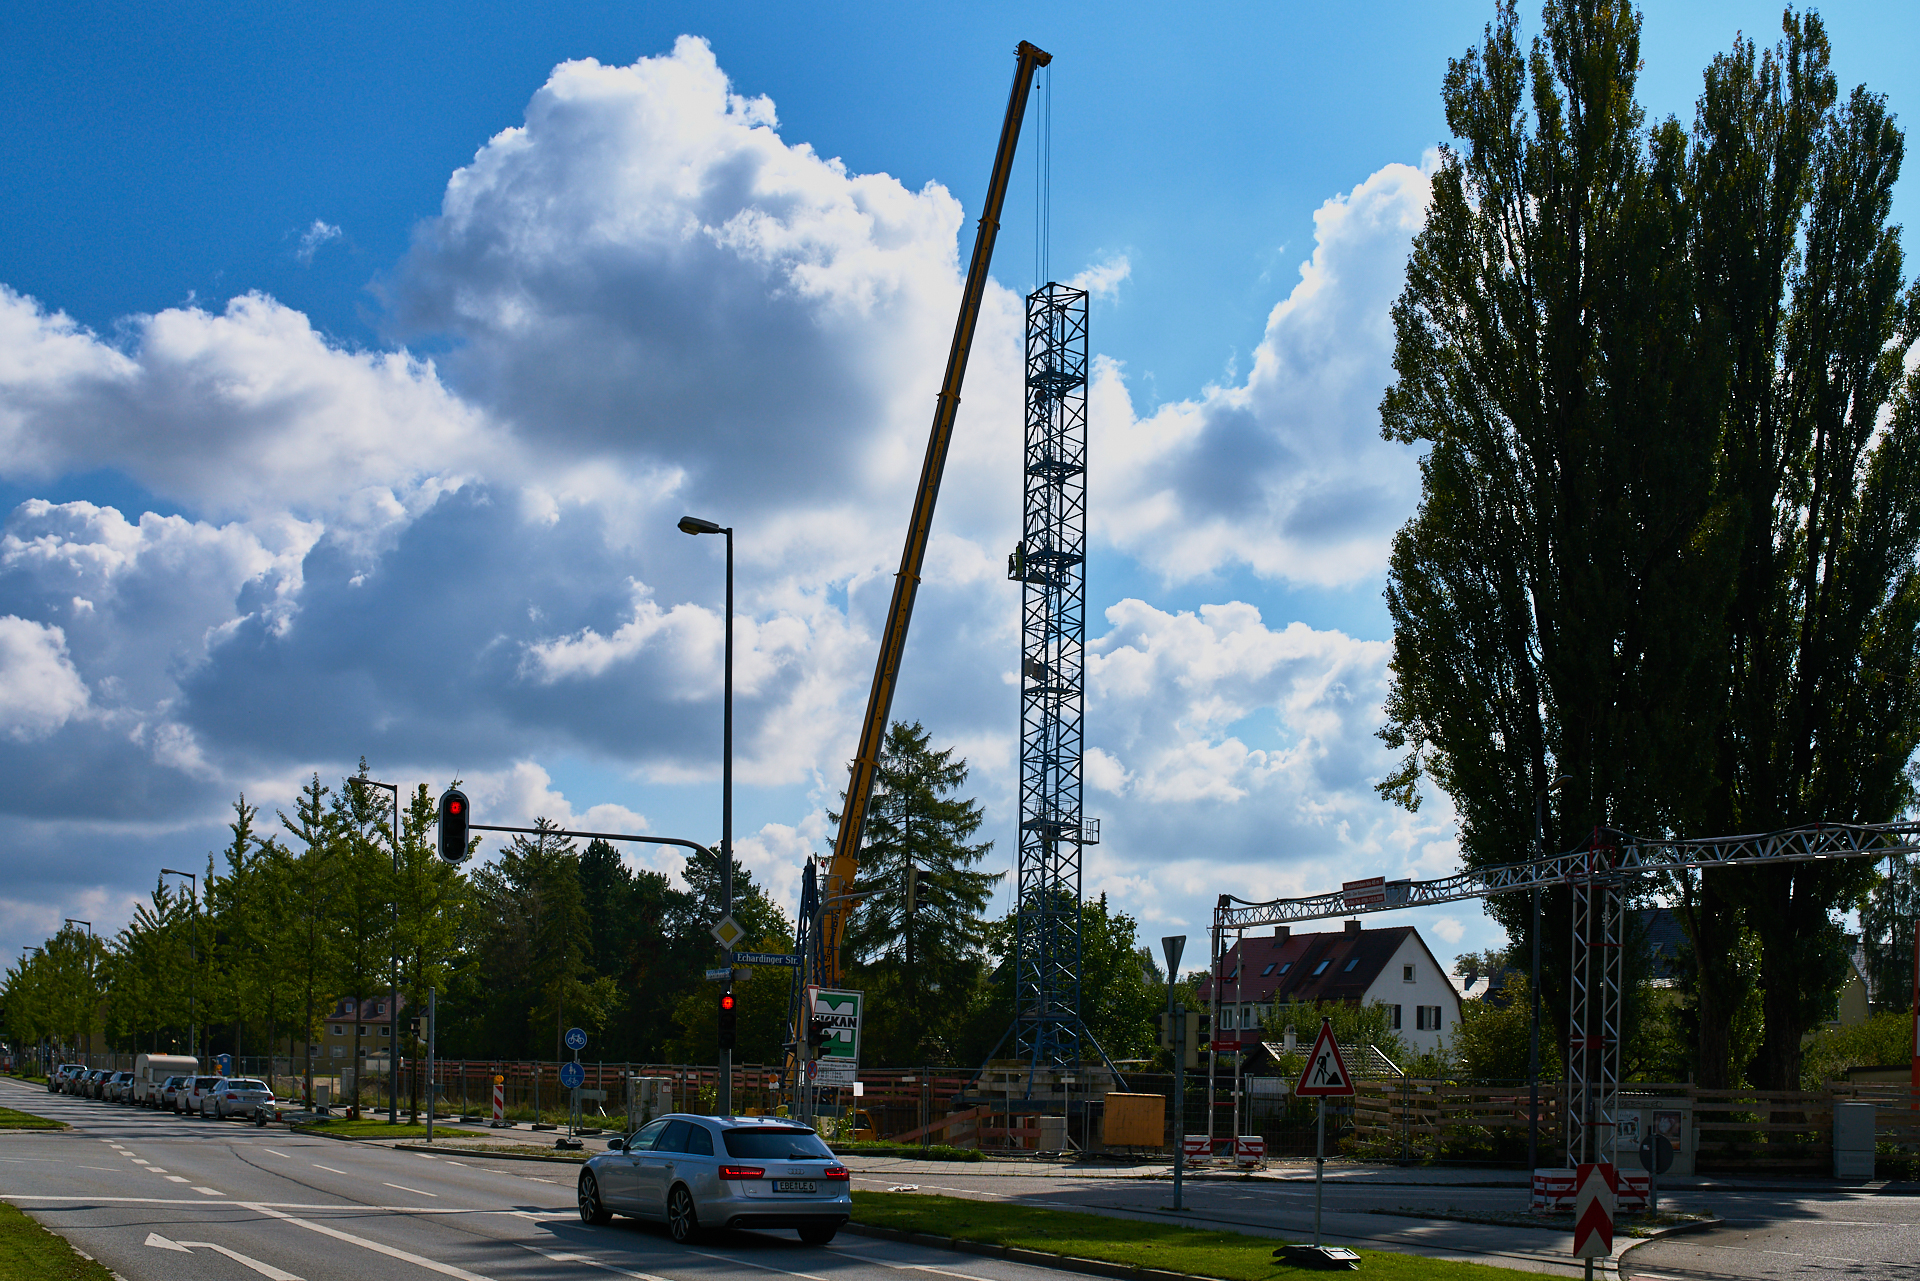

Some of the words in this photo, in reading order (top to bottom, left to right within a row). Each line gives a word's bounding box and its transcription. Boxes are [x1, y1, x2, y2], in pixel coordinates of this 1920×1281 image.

[737, 953, 783, 965] Echardinger
[785, 955, 799, 965] Str.
[780, 1181, 795, 1190] EBE
[798, 1182, 808, 1190] LE
